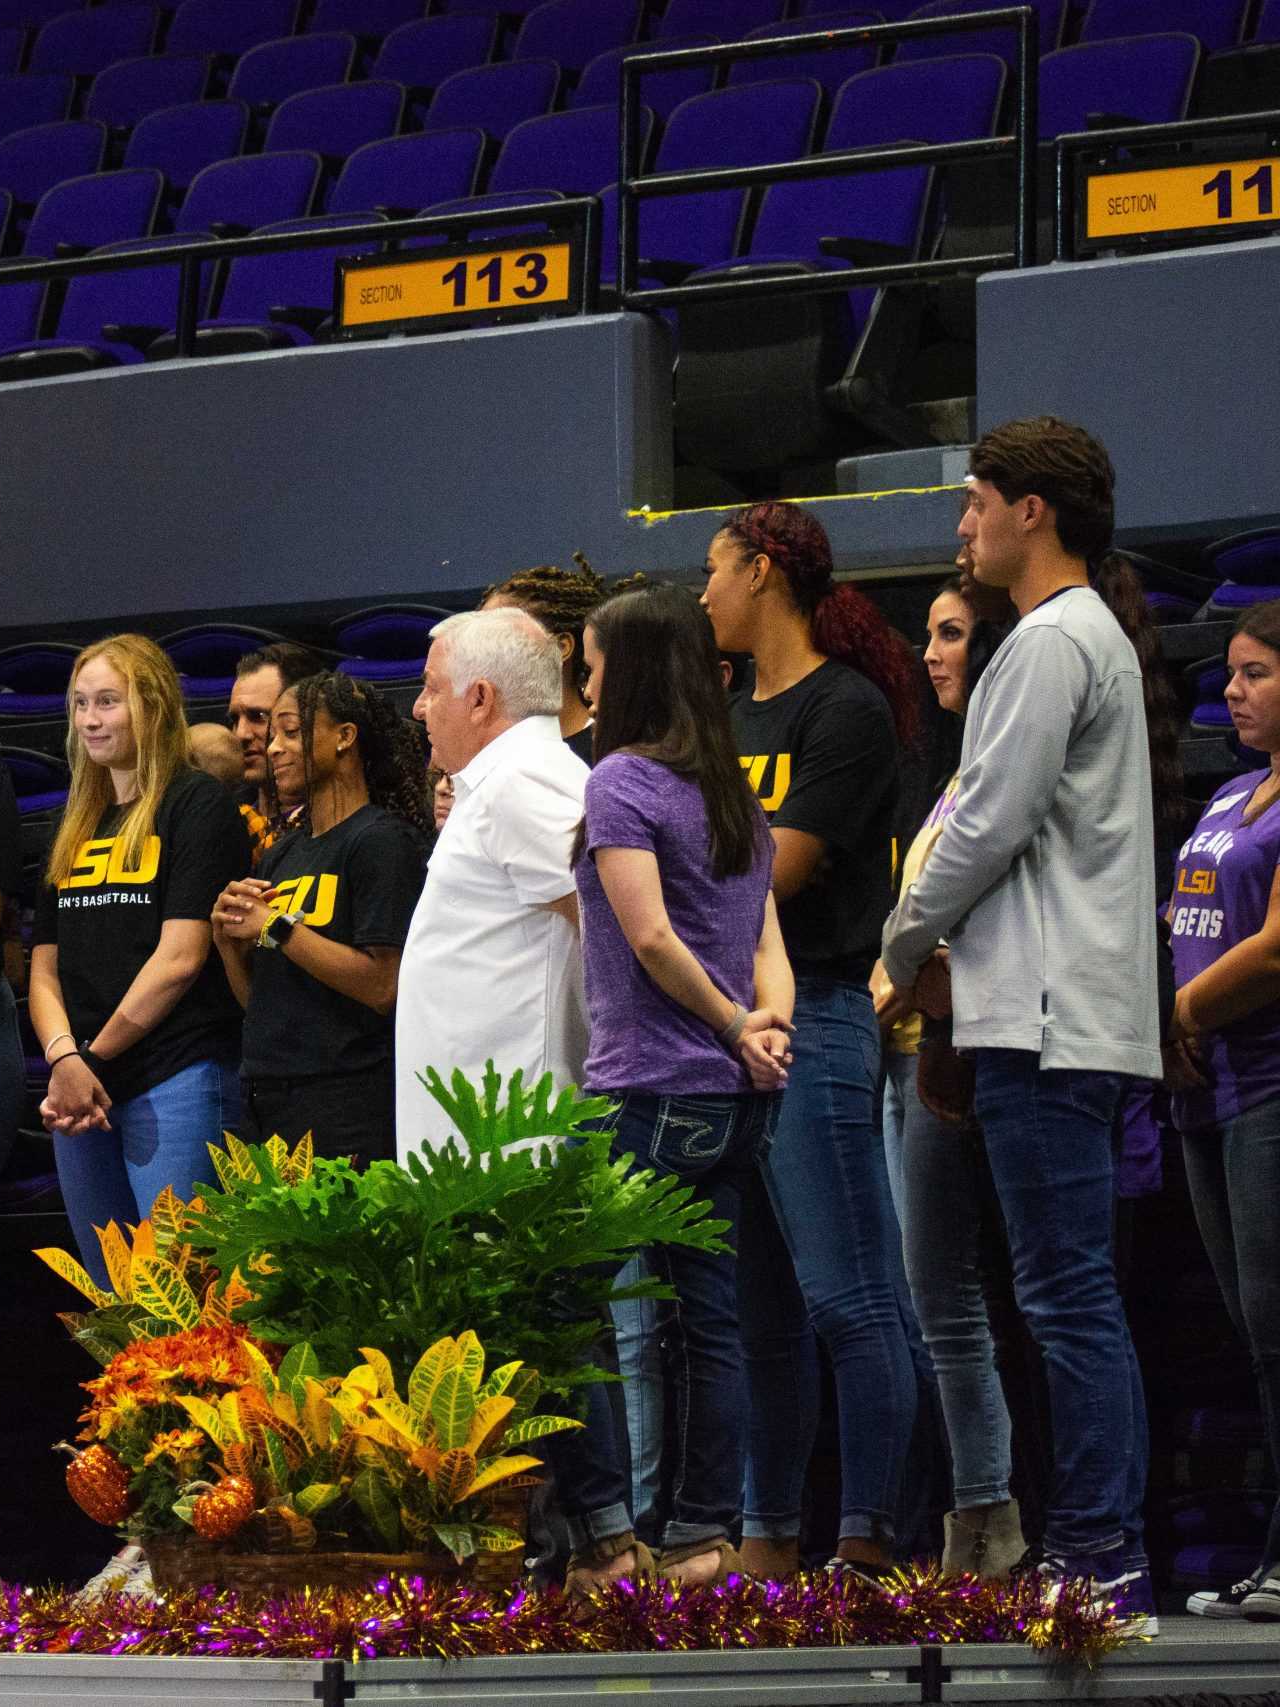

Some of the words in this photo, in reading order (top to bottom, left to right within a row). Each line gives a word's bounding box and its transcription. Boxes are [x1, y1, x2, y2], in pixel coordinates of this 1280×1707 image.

[1107, 194, 1157, 216] SECTION
[359, 284, 403, 305] SECTION
[442, 252, 548, 307] 113
[57, 834, 161, 890] SU
[1177, 868, 1217, 895] LSU
[58, 896, 80, 908] EN'S
[82, 892, 151, 907] BASKETBALL
[1172, 906, 1225, 938] GERS
